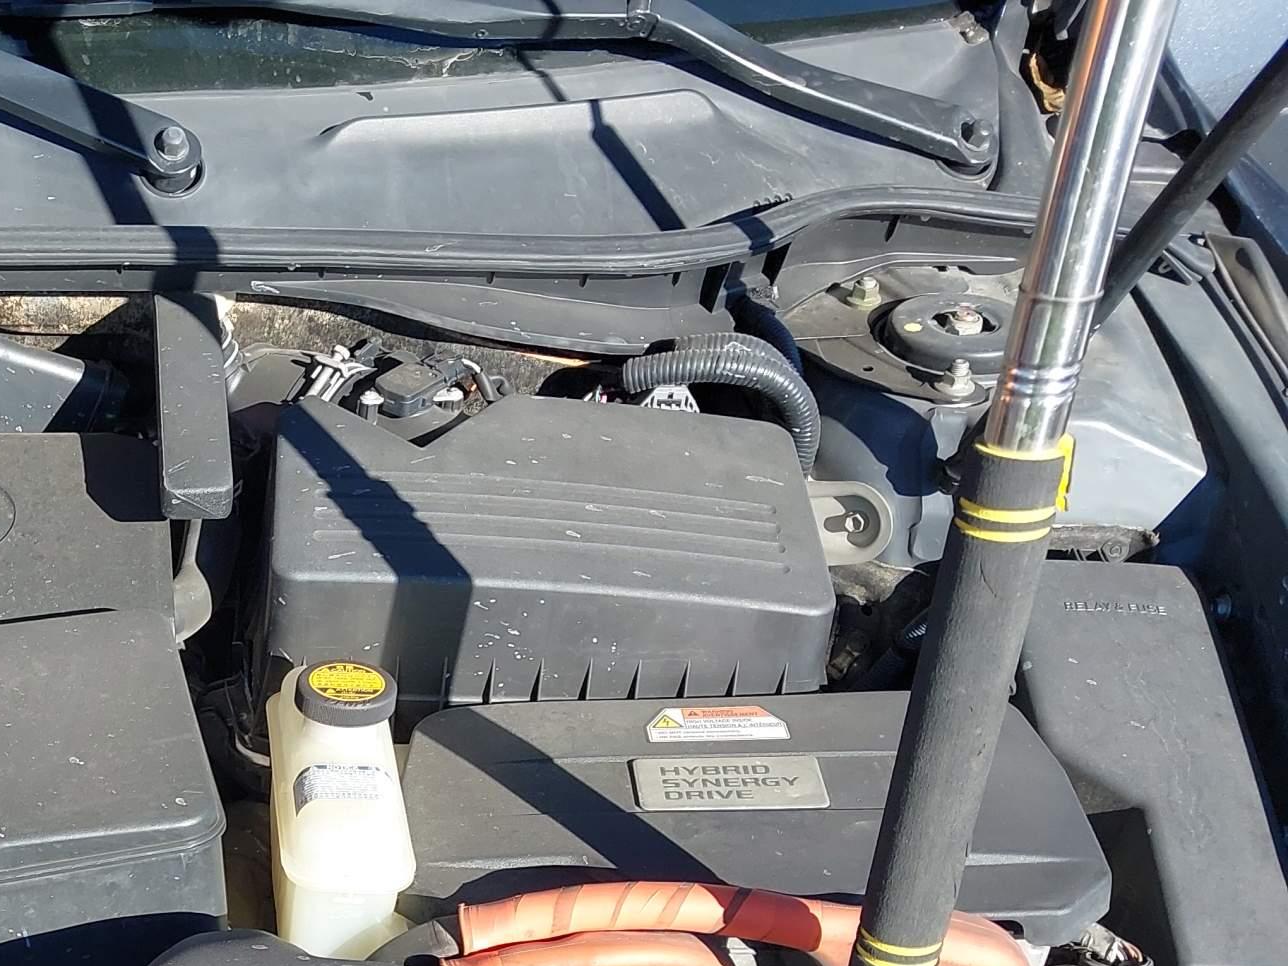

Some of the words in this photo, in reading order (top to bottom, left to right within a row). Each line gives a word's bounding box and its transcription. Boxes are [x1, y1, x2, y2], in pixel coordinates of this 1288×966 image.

[1064, 601, 1111, 612] RELAY
[1114, 602, 1125, 612] &
[1128, 603, 1168, 615] FUSE
[660, 765, 770, 776] HYBRID
[662, 776, 799, 788] SYNERGY
[663, 789, 754, 800] DRIVE
